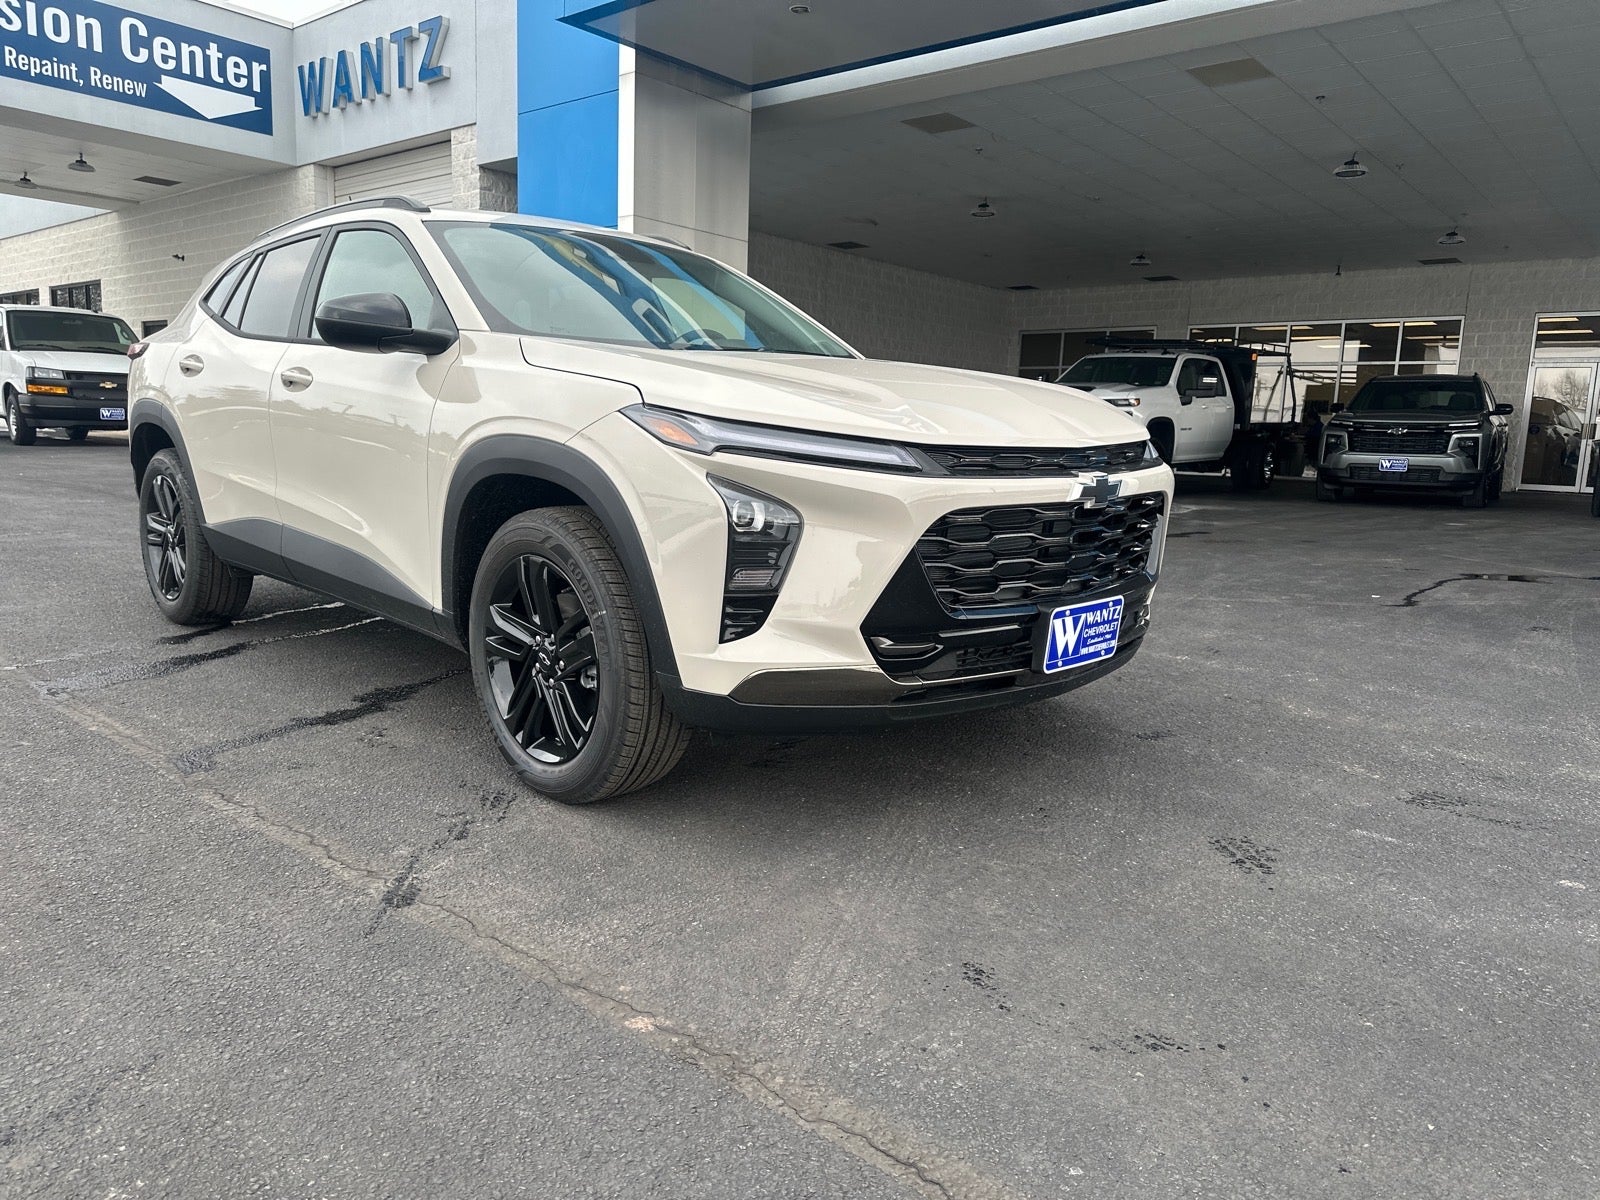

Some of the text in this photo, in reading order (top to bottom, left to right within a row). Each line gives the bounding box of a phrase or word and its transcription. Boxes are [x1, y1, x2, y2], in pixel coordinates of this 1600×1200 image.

[4, 45, 147, 97] Repaint, Renew
[120, 17, 267, 92] Center
[298, 15, 451, 118] WANTZ
[1381, 460, 1393, 469] W
[1053, 613, 1086, 659] W
[1084, 621, 1118, 637] CHEVROLET
[1086, 605, 1121, 625] WANTZ
